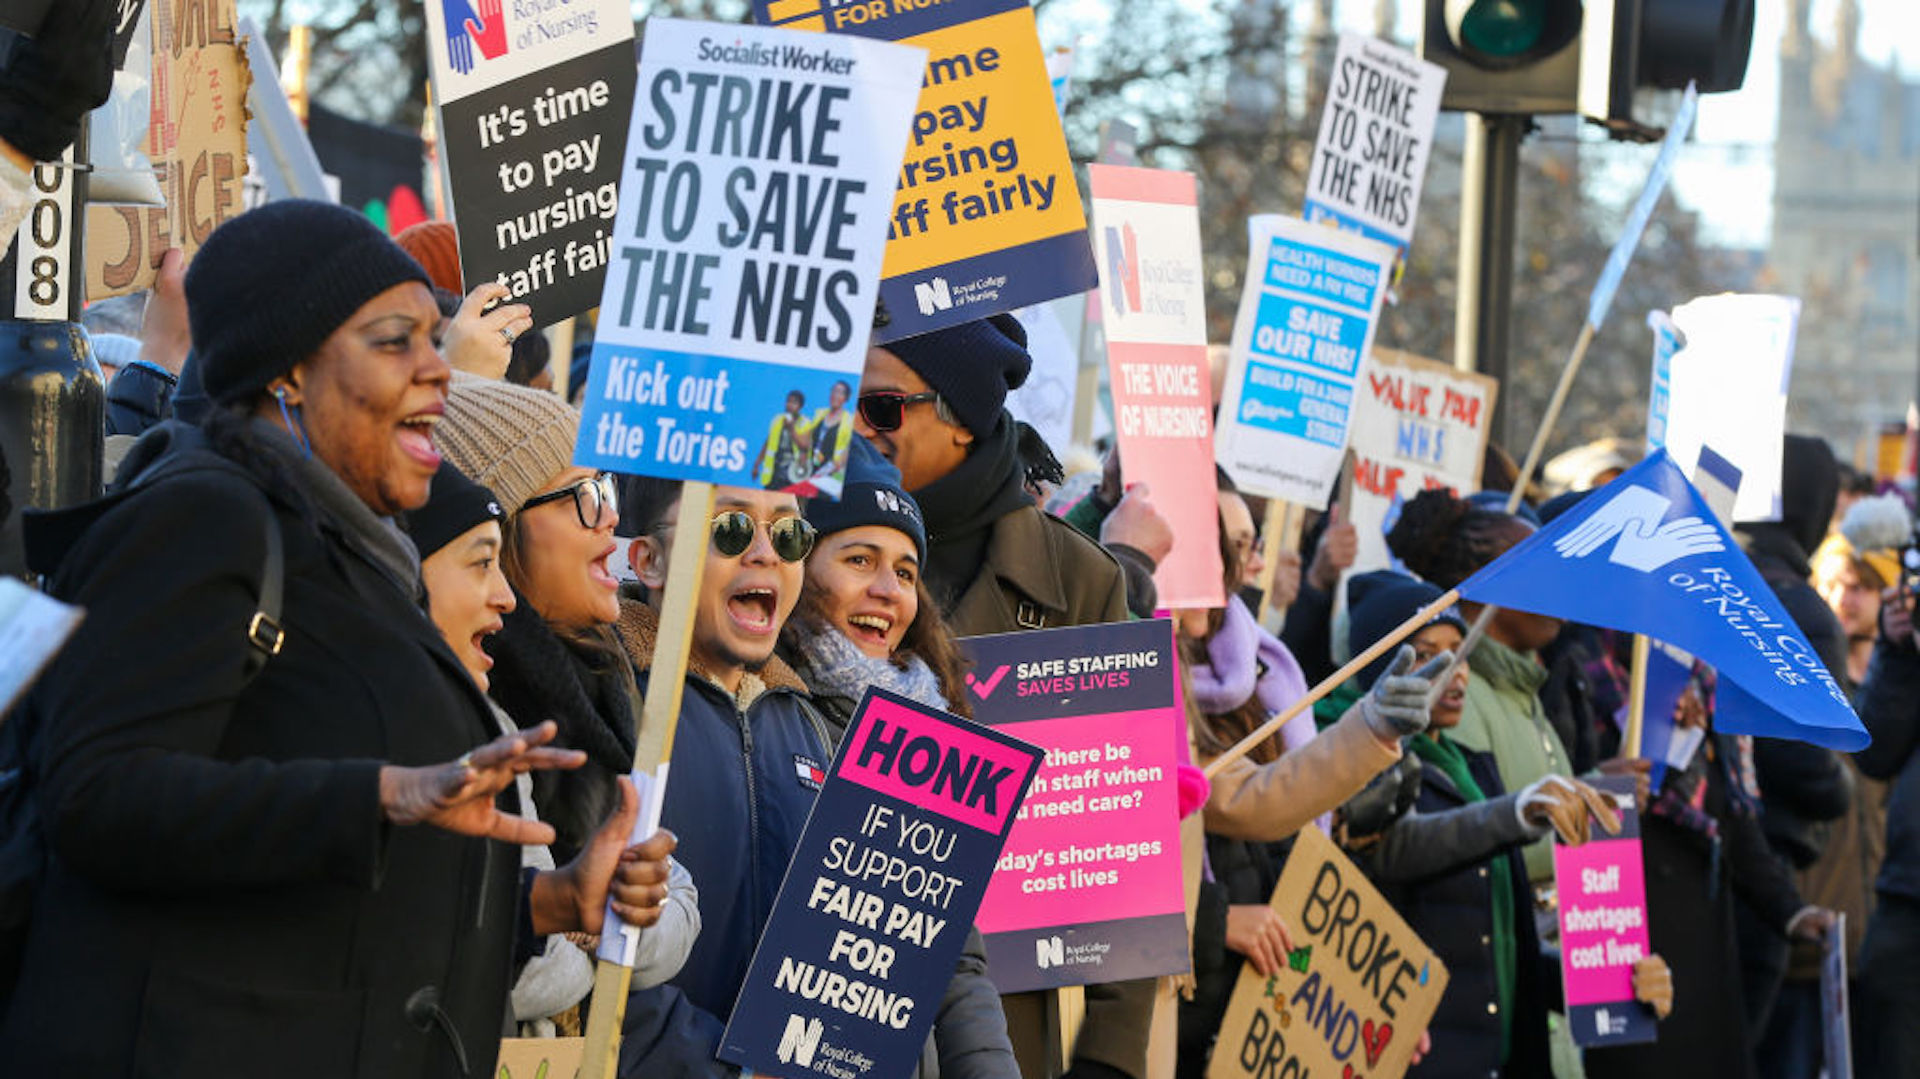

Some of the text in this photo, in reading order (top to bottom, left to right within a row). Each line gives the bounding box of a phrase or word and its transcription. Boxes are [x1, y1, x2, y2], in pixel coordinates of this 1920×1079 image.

[536, 9, 598, 43] Nursing
[833, 1, 887, 29] FOR
[921, 47, 1001, 89] ime
[1337, 56, 1419, 129] STRIKE
[478, 79, 610, 149] It's time
[643, 68, 852, 168] STRIKE
[913, 95, 989, 146] pay
[498, 134, 602, 193] to pay
[1329, 103, 1421, 180] TO SAVE
[634, 157, 702, 243] TO
[716, 166, 867, 262] SAVE
[941, 174, 1056, 226] fairly
[1318, 149, 1363, 206] THE
[1364, 174, 1413, 229] NHS
[496, 182, 618, 250] nursing
[496, 249, 558, 304] taff
[618, 246, 860, 353] THE NHS
[1256, 325, 1357, 371] OUR NHS!
[1288, 306, 1344, 341] SAVE
[604, 355, 731, 413] Kick out
[1120, 363, 1200, 397] THE VOICE
[1369, 371, 1430, 417] VALUE
[595, 412, 748, 472] the Tories
[1121, 405, 1141, 438] OF
[1143, 405, 1208, 440] NURSING
[1396, 420, 1446, 462] NHS
[1701, 566, 1784, 629] Royal
[1668, 572, 1810, 687] of Nursing
[1016, 650, 1160, 680] SAFE STAFFING
[1016, 671, 1131, 697] SAVES LIVES
[856, 716, 1015, 818] HONK
[1045, 742, 1133, 769] there be
[1051, 769, 1101, 792] staff
[1104, 765, 1164, 788] when
[1032, 795, 1085, 819] need
[1088, 790, 1145, 812] care?
[859, 803, 958, 864] IF YOU
[1058, 837, 1163, 868] shortages
[822, 836, 965, 910] SUPPORT
[1021, 868, 1120, 895] cost lives
[1581, 864, 1621, 895] Staff
[807, 876, 947, 950] FAIR PAY
[1565, 905, 1643, 935] shortages
[828, 929, 897, 982] FOR
[1302, 861, 1418, 1020] BROKE
[1570, 941, 1605, 969] cost
[774, 956, 915, 1029] NURSING
[1291, 971, 1361, 1062] AND
[820, 1042, 847, 1062] Royal
